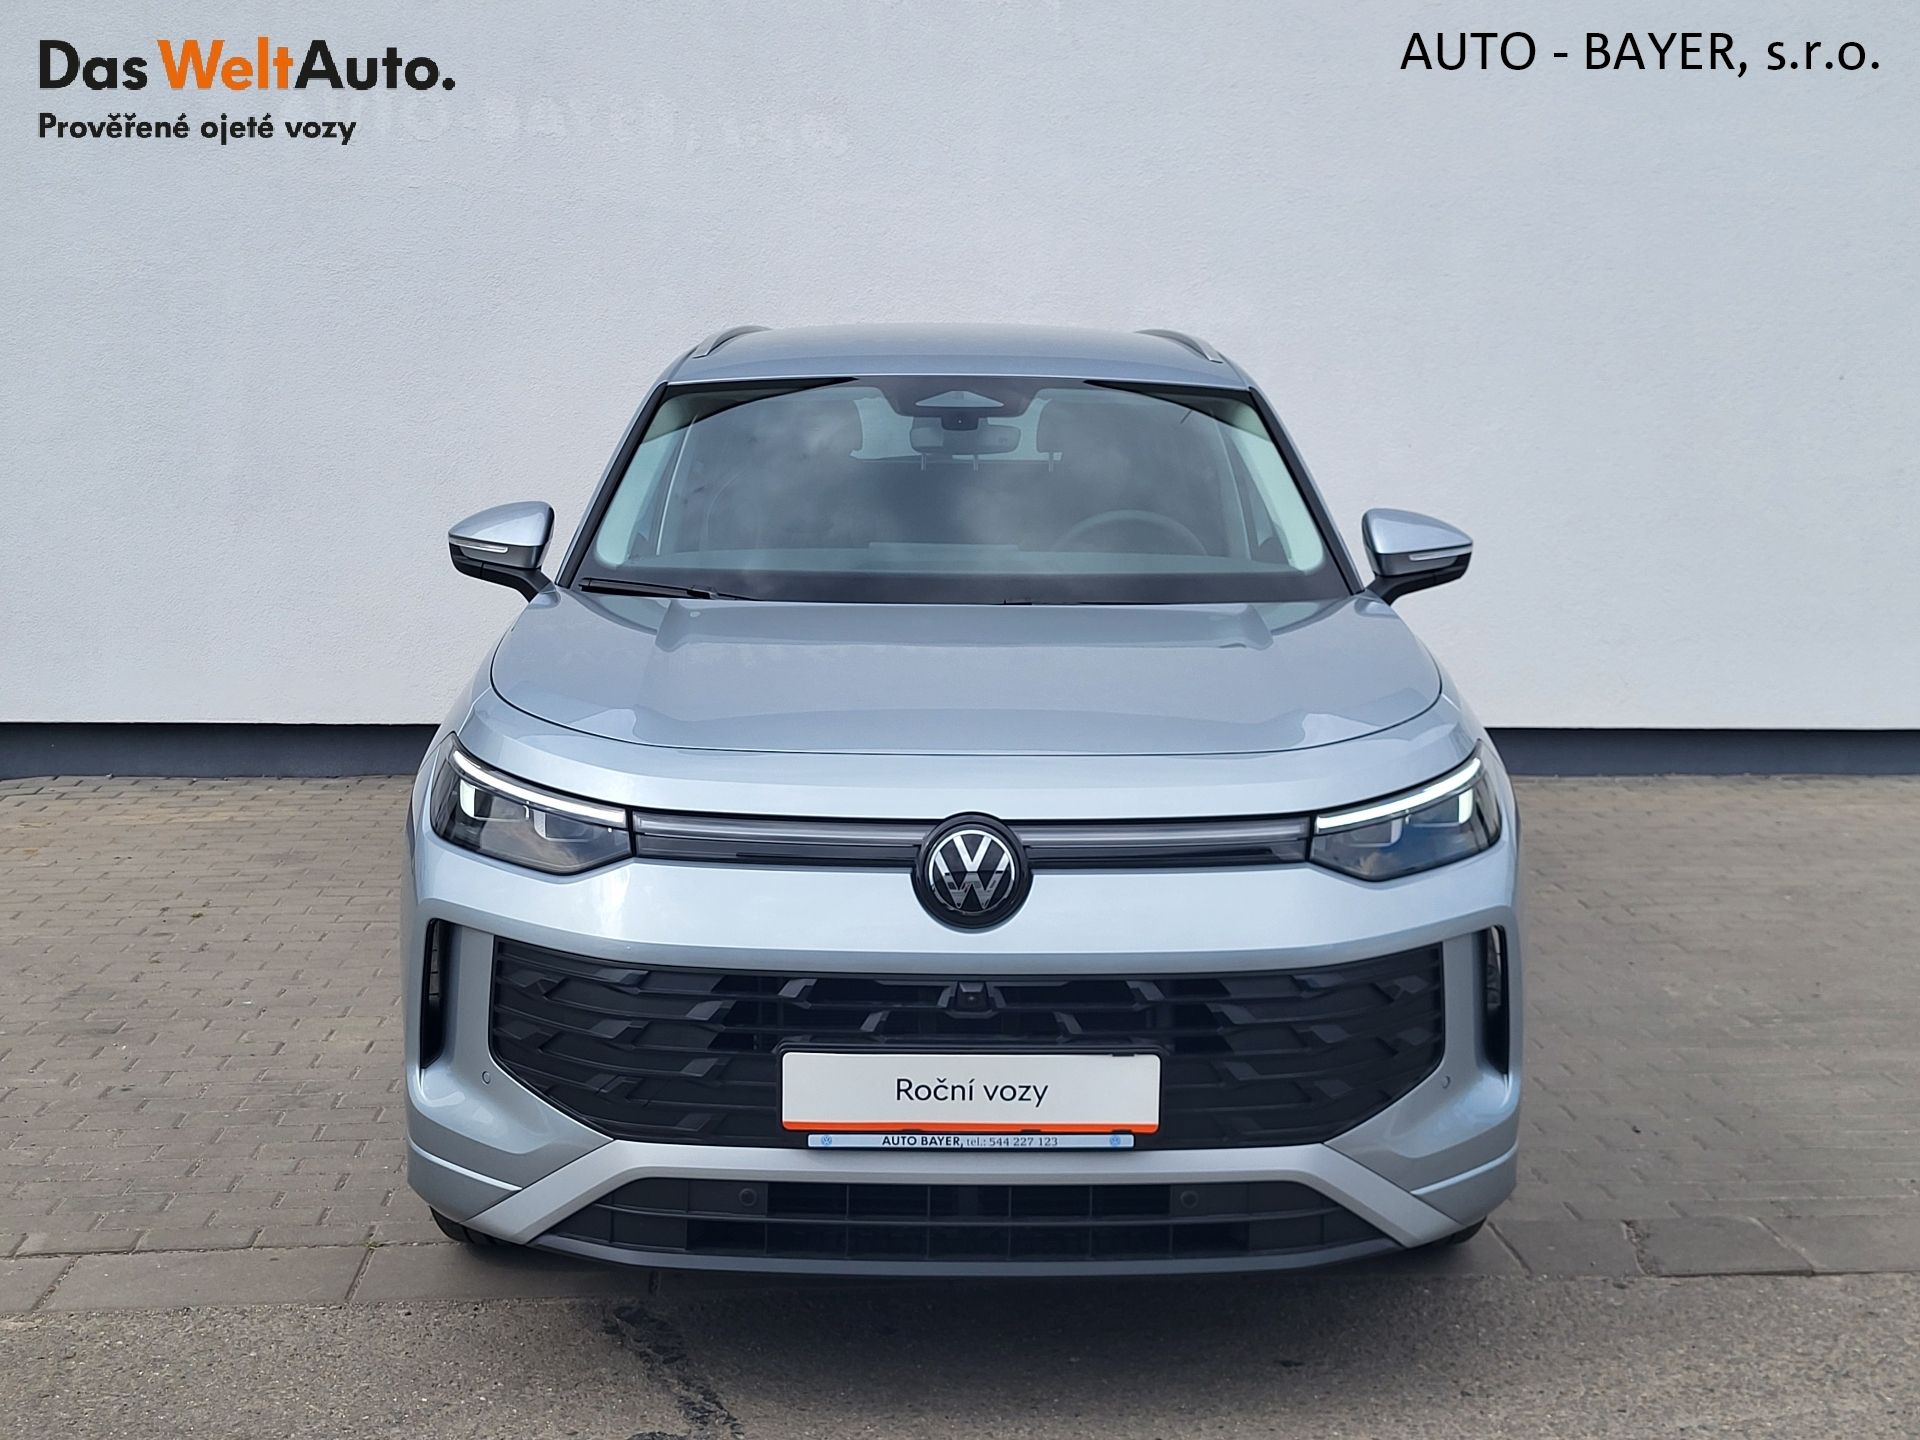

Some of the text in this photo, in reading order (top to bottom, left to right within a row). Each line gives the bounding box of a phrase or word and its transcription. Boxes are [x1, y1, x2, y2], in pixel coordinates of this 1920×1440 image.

[896, 1077, 1049, 1108] Roční vozy
[882, 1136, 917, 1146] AUTO
[921, 1136, 964, 1148] BAYER,
[989, 1137, 1010, 1147] 544
[1013, 1137, 1034, 1147] 227
[1038, 1137, 1058, 1147] 123
